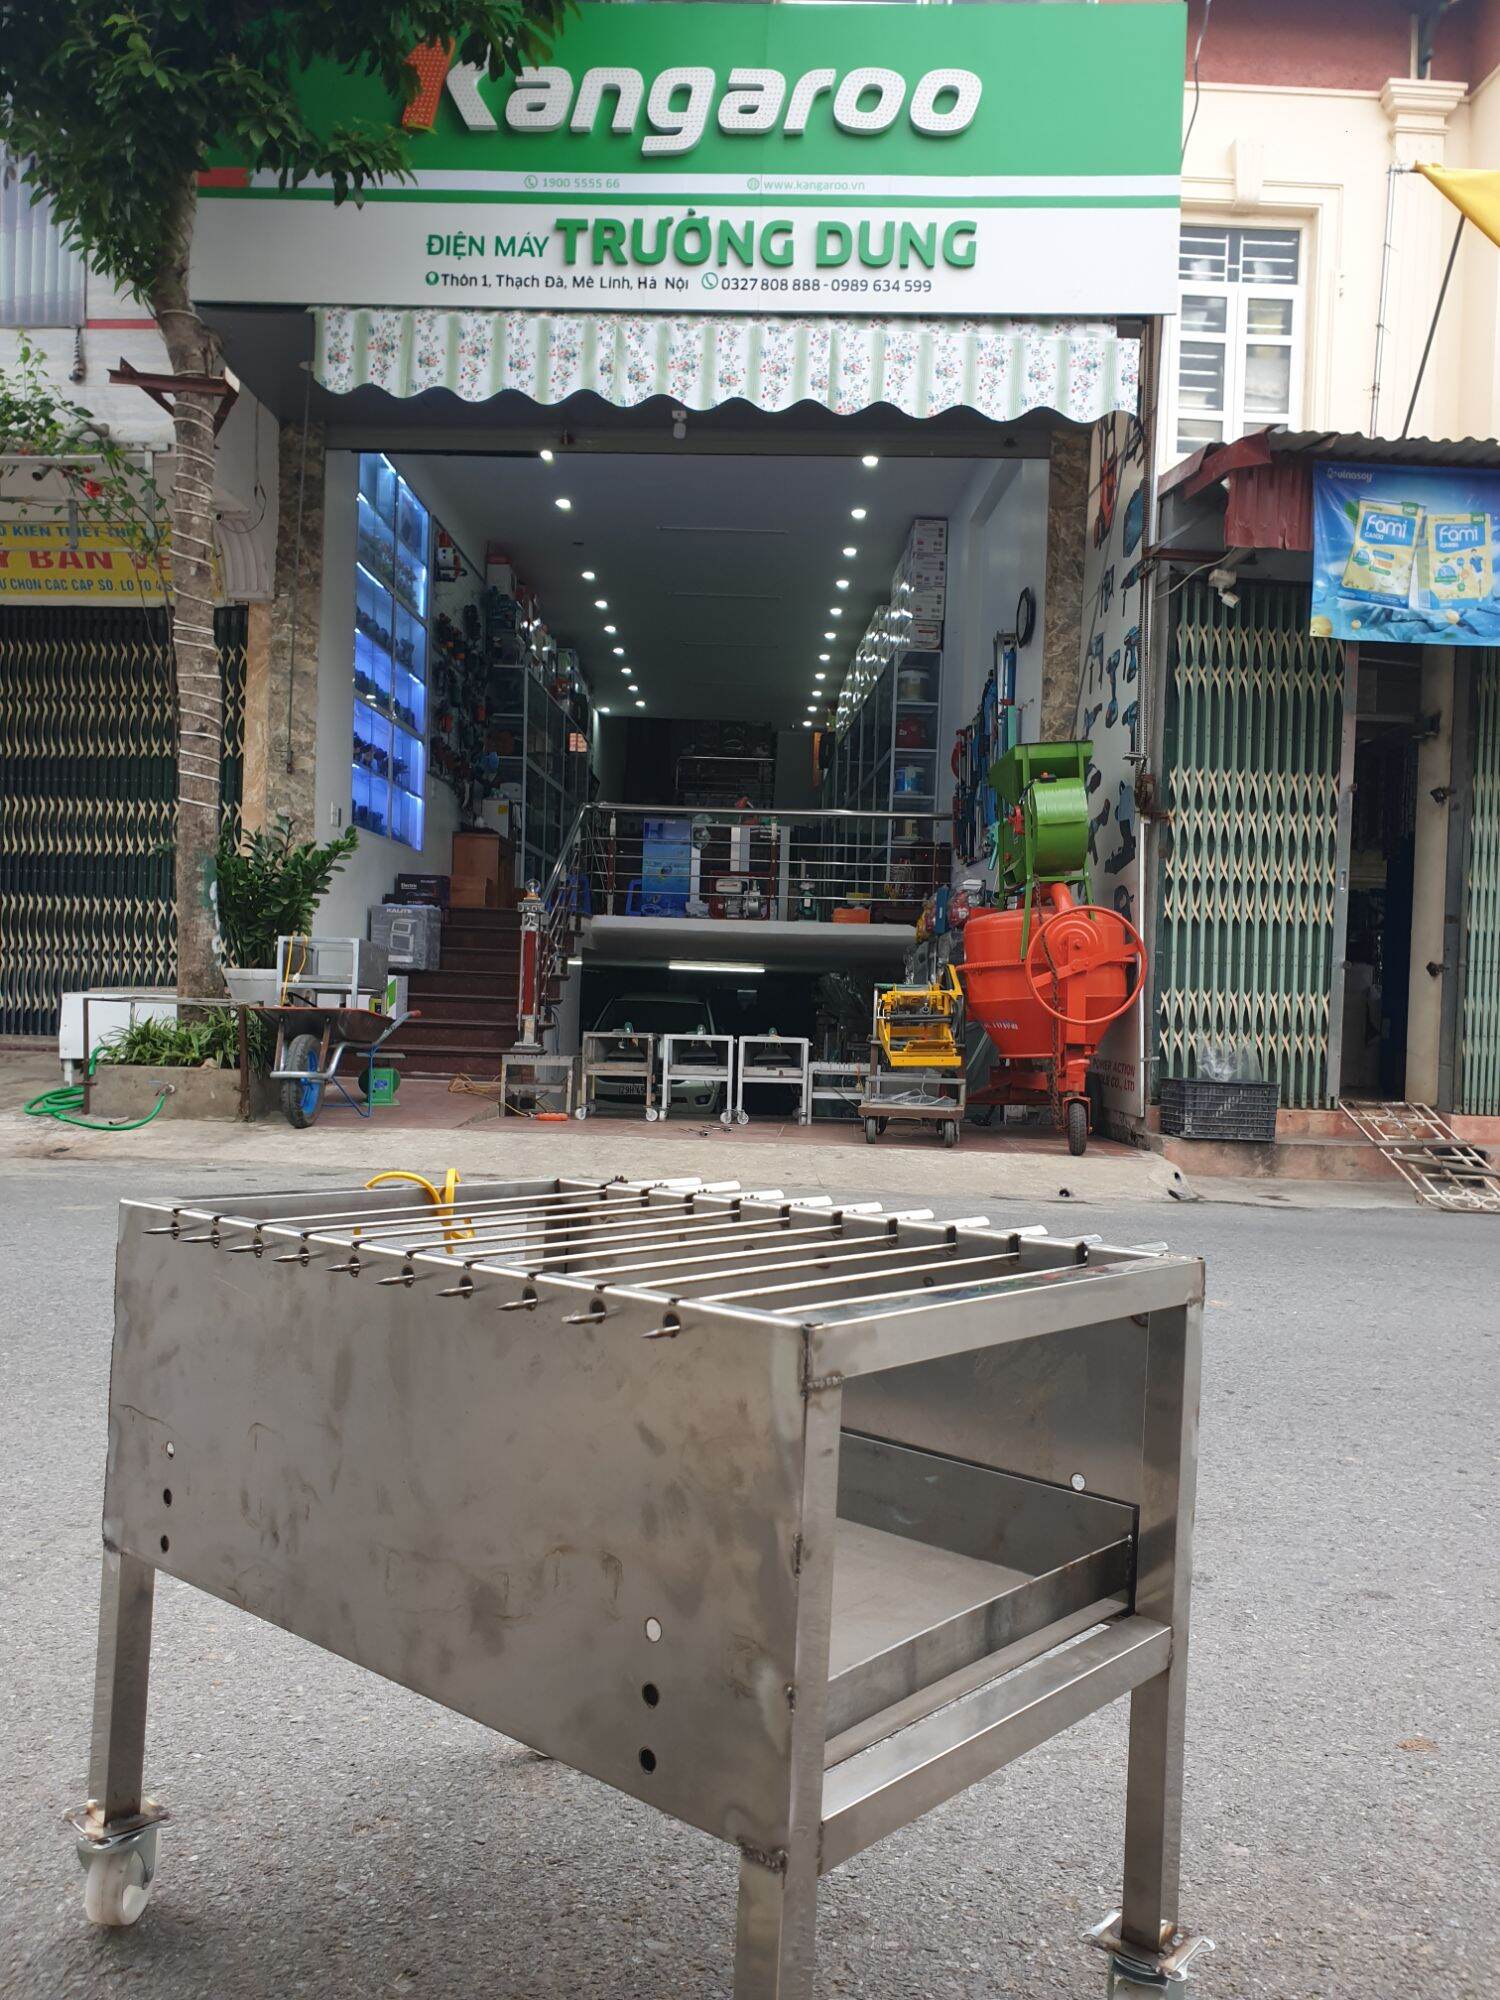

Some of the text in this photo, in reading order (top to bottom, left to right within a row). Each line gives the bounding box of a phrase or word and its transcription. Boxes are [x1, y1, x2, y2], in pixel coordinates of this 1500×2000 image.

[403, 34, 983, 157] Kangaroo
[542, 177, 621, 189] 1900 5555 66
[763, 178, 866, 192] www.kangaroo.vn
[426, 231, 485, 260] ĐIỆN
[494, 231, 549, 257] MÁY
[816, 220, 978, 269] DUNG
[441, 273, 478, 287] Thôn
[481, 274, 492, 288] 1,
[496, 274, 540, 289] Thạch
[572, 275, 594, 288] Mê
[600, 276, 633, 290] Linh,
[664, 276, 689, 292] Nội
[721, 277, 757, 291] 0327
[760, 278, 788, 291] 808
[872, 279, 900, 292] 634
[904, 279, 932, 293] 599
